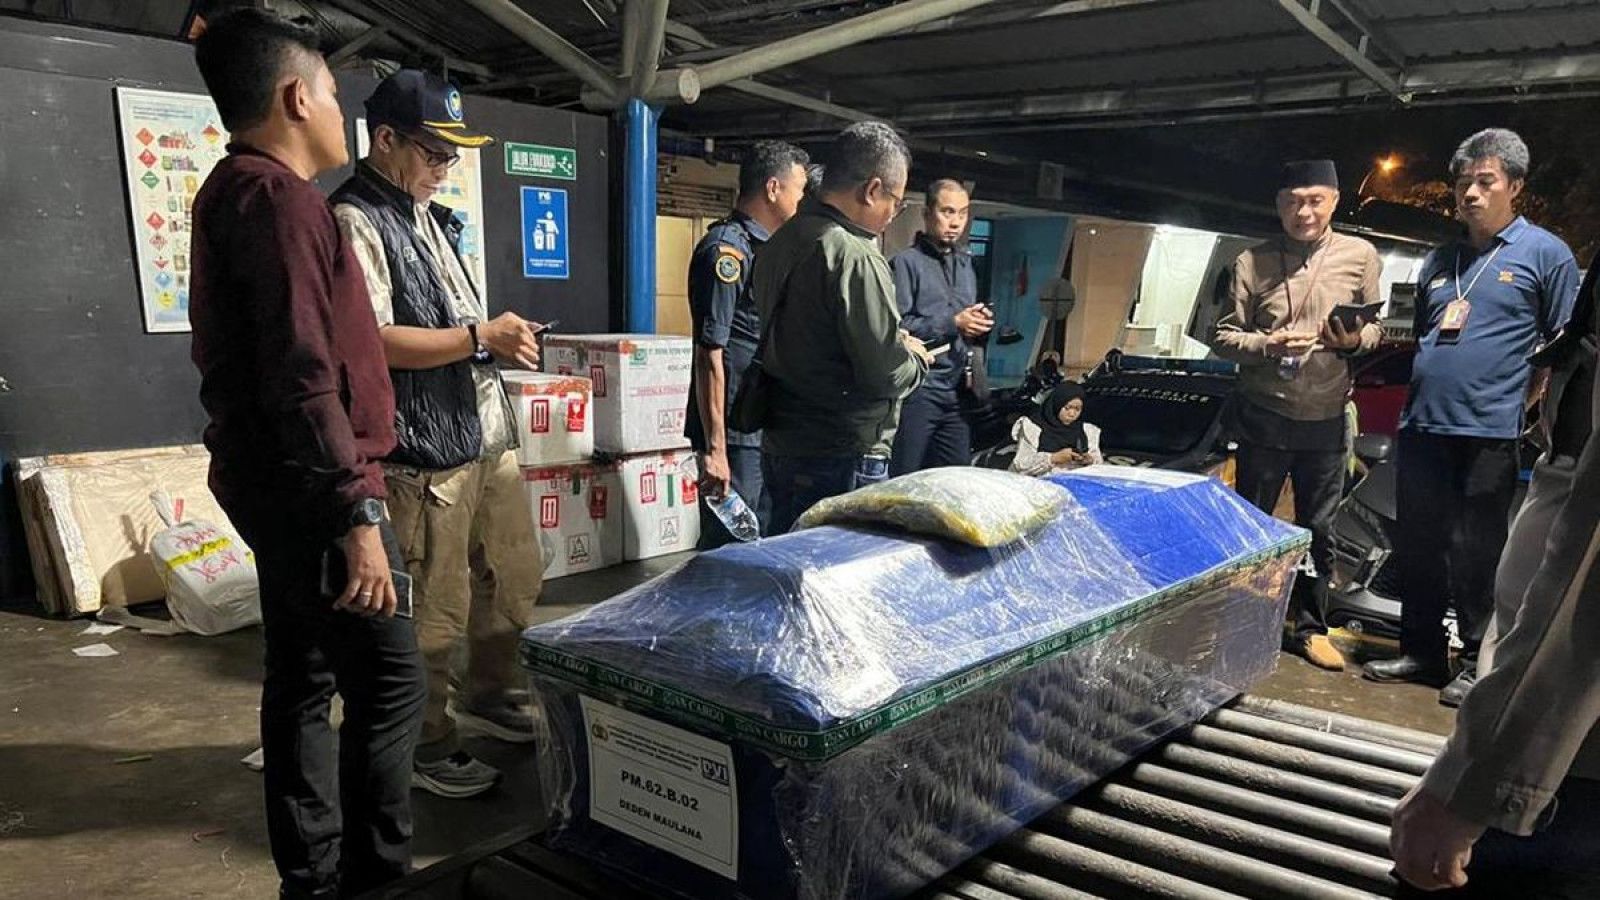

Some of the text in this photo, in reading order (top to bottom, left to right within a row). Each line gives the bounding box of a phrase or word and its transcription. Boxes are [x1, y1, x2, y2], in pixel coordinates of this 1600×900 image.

[763, 729, 809, 748] CARGO
[620, 769, 700, 811] PM.62.B.02
[619, 798, 703, 841] DEDEN MAULANA
